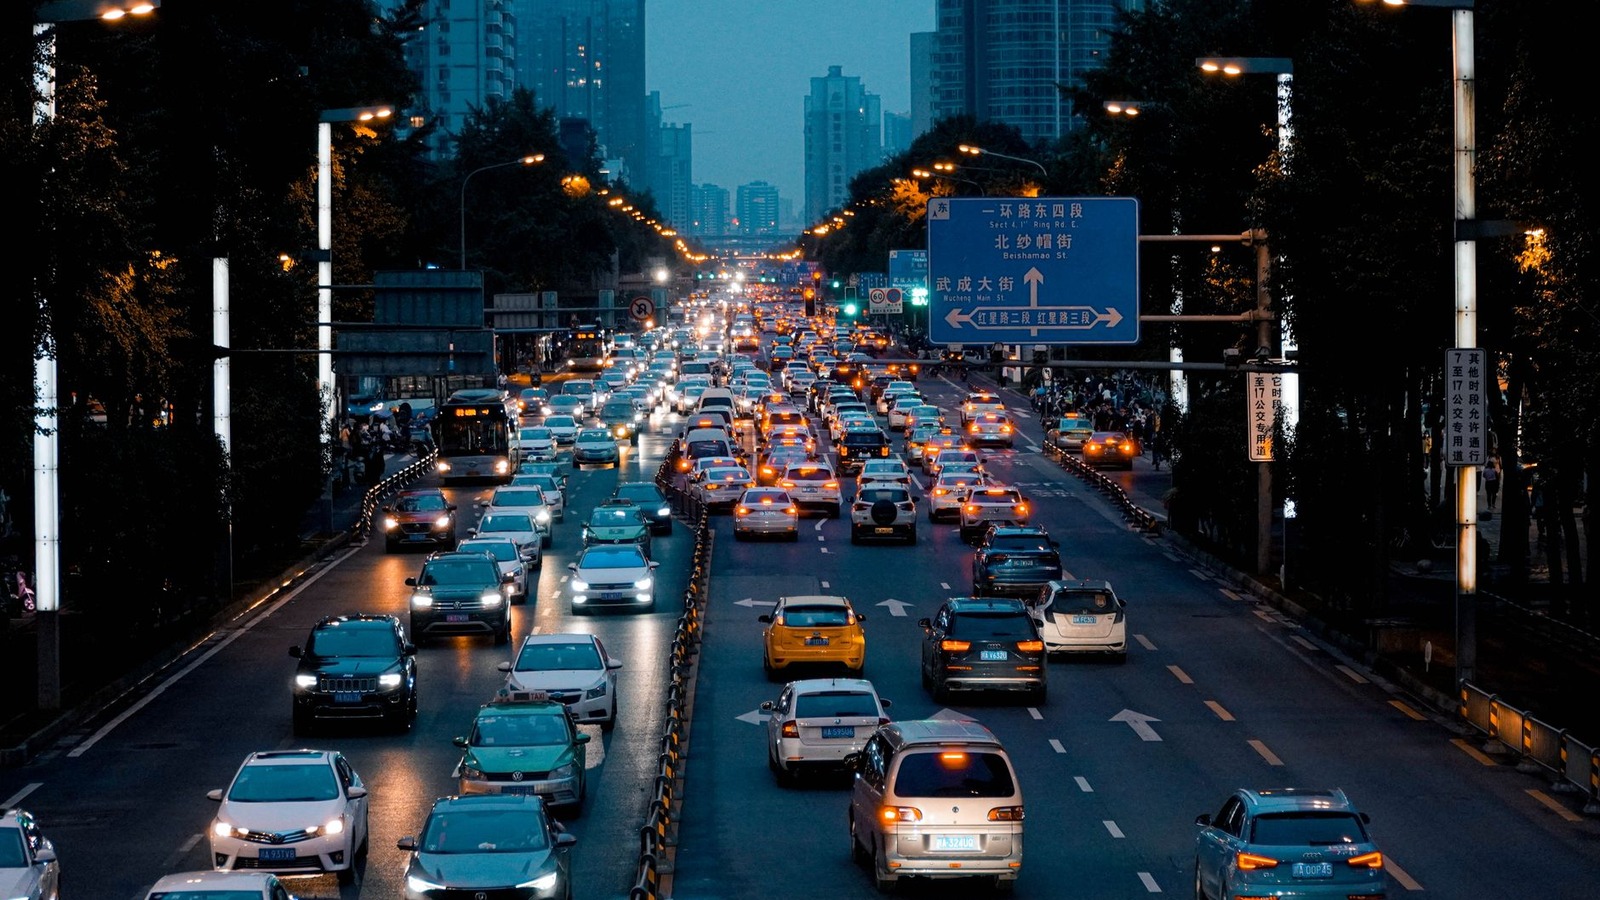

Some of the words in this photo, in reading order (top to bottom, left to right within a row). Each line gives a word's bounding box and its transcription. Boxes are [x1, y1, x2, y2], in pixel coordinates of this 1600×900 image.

[938, 202, 948, 212] 东
[982, 203, 1083, 218] 一环路东四段
[1034, 221, 1050, 229] Ring
[994, 234, 1072, 249] 北纱帽街
[936, 276, 1013, 292] 武成大街
[978, 312, 1030, 324] 红星路二段
[1037, 312, 1090, 324] 红星路三段
[1254, 373, 1265, 456] 至17公交专用道
[1452, 353, 1463, 462] 7至17公交专用道
[1468, 353, 1479, 462] 其他时段允许通行
